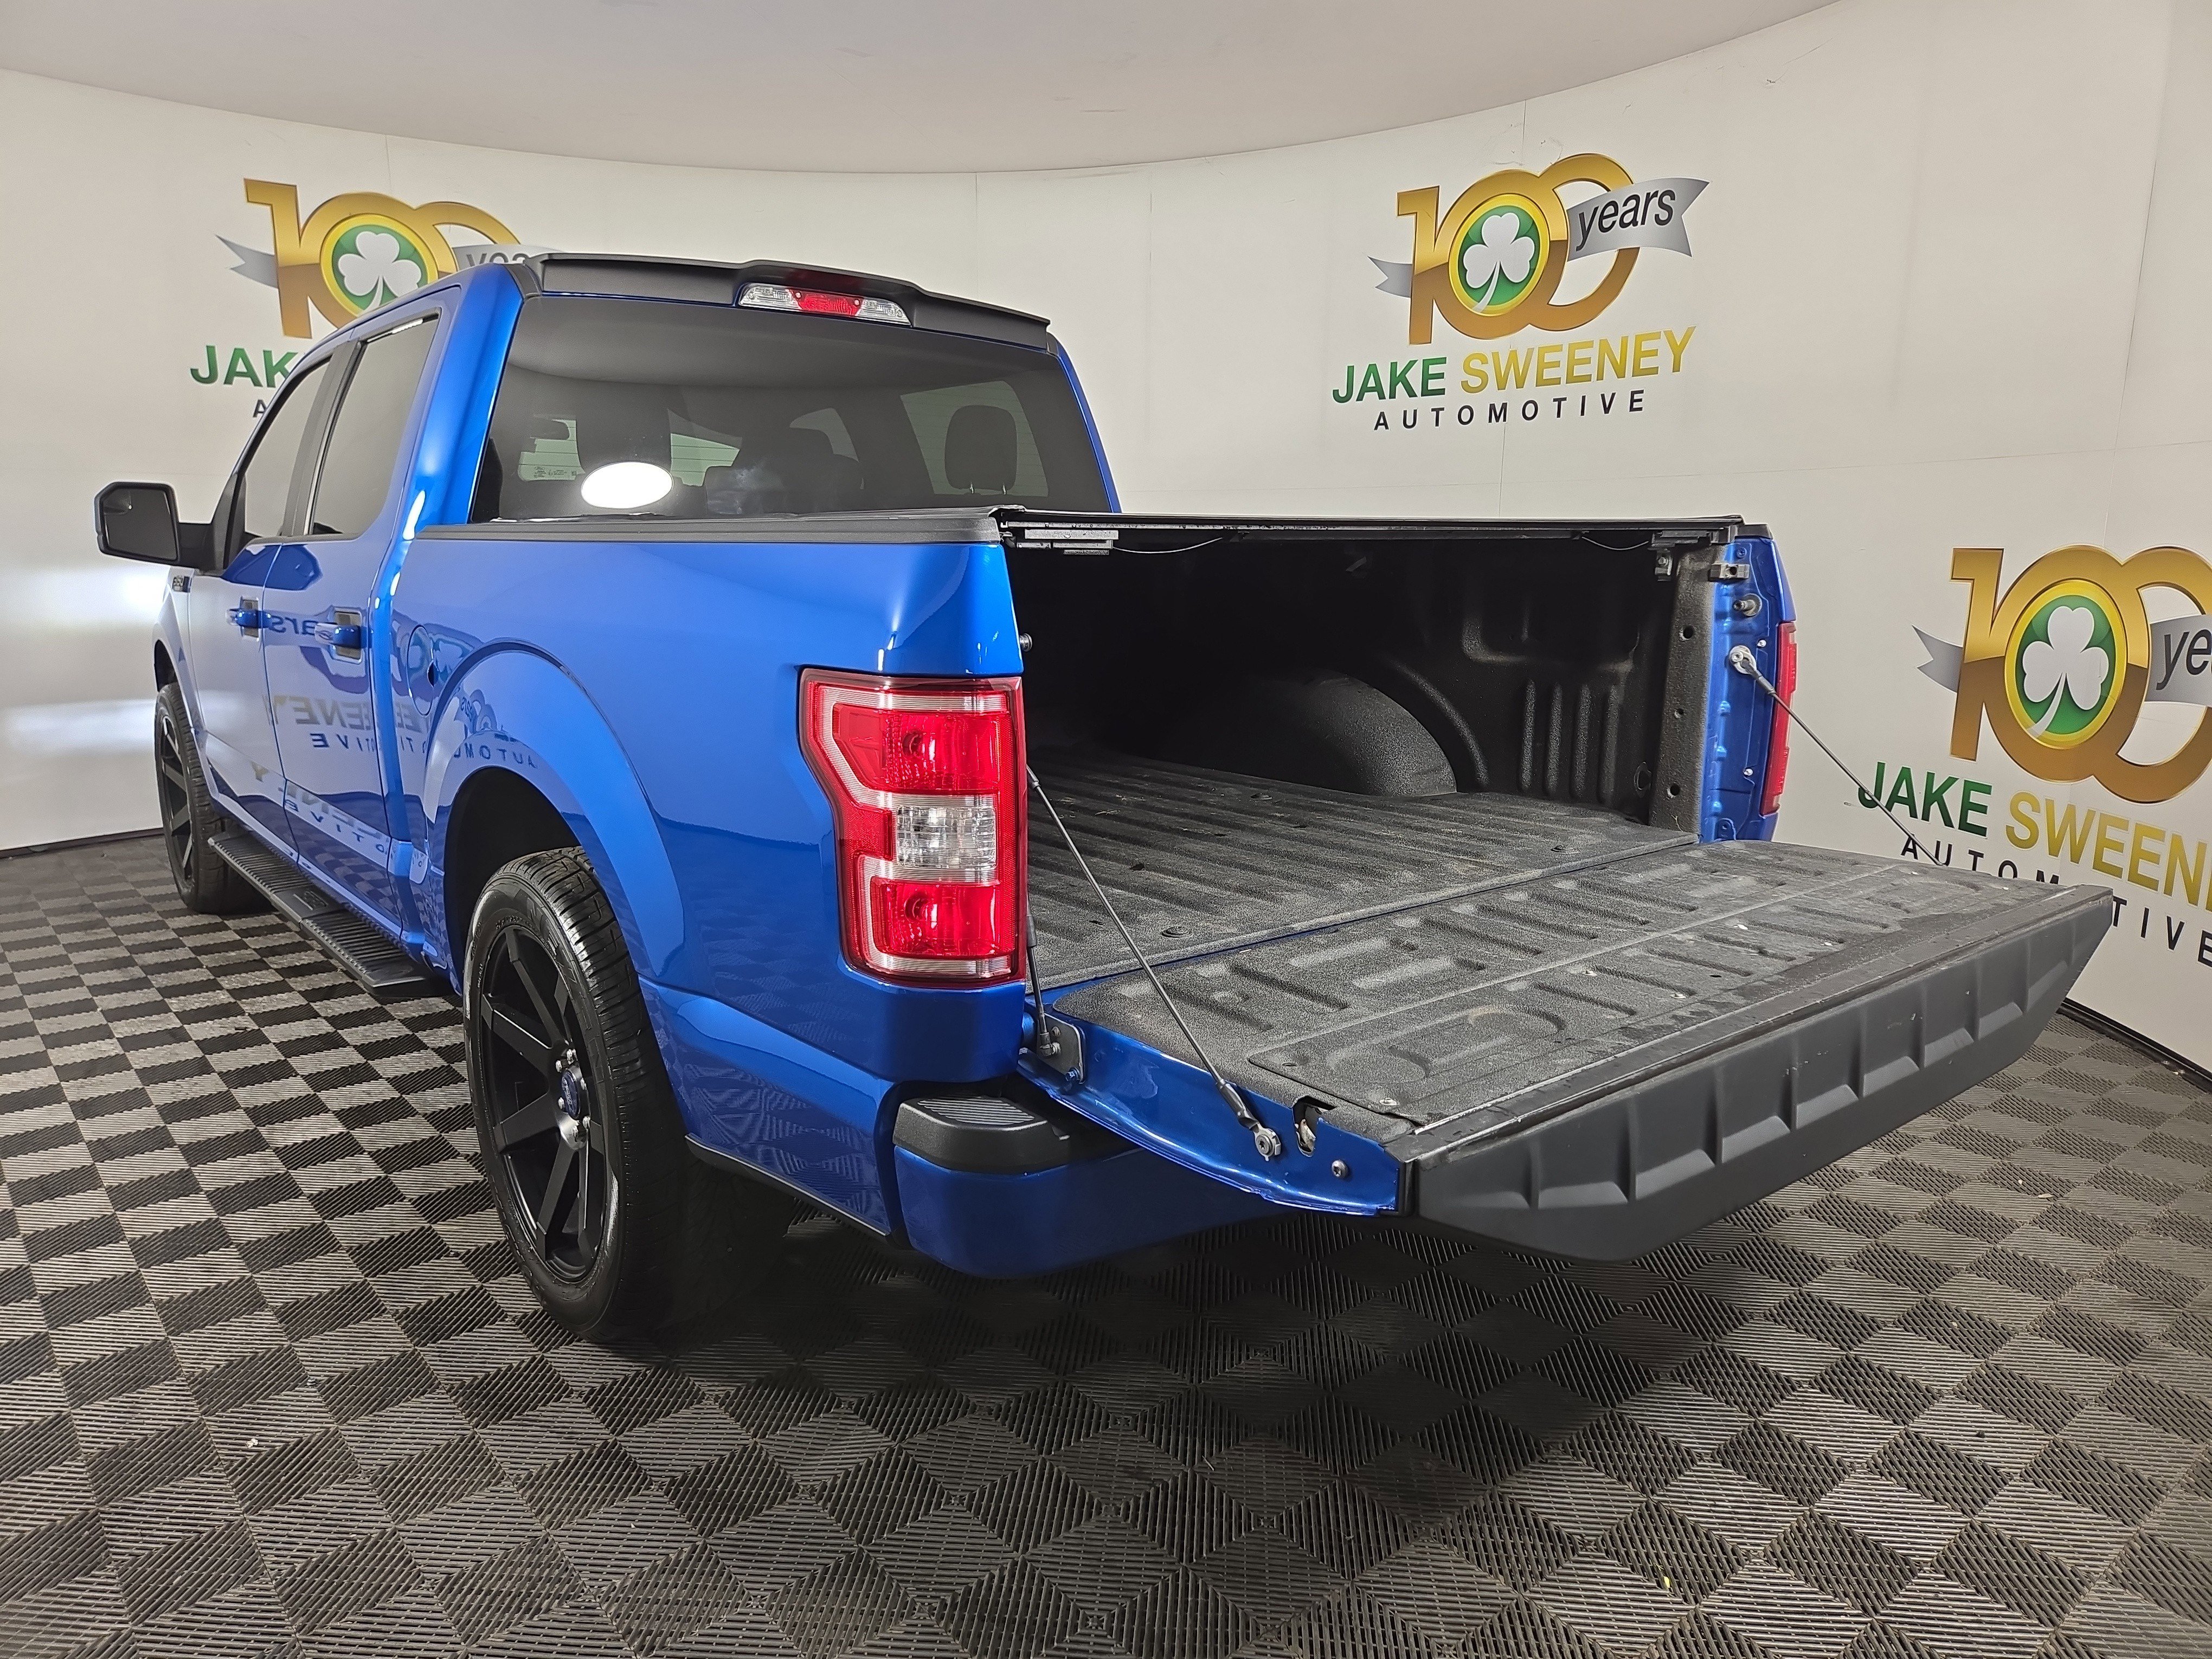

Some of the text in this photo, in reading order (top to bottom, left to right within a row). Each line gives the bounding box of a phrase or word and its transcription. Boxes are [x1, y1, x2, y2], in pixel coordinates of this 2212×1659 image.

[1397, 152, 1676, 345] 100 years
[190, 344, 299, 388] JAK
[1332, 325, 1697, 403] JAKE SWEENEY
[1374, 389, 1645, 431] AUTOMOTIVE
[1857, 761, 1992, 837] JAKE
